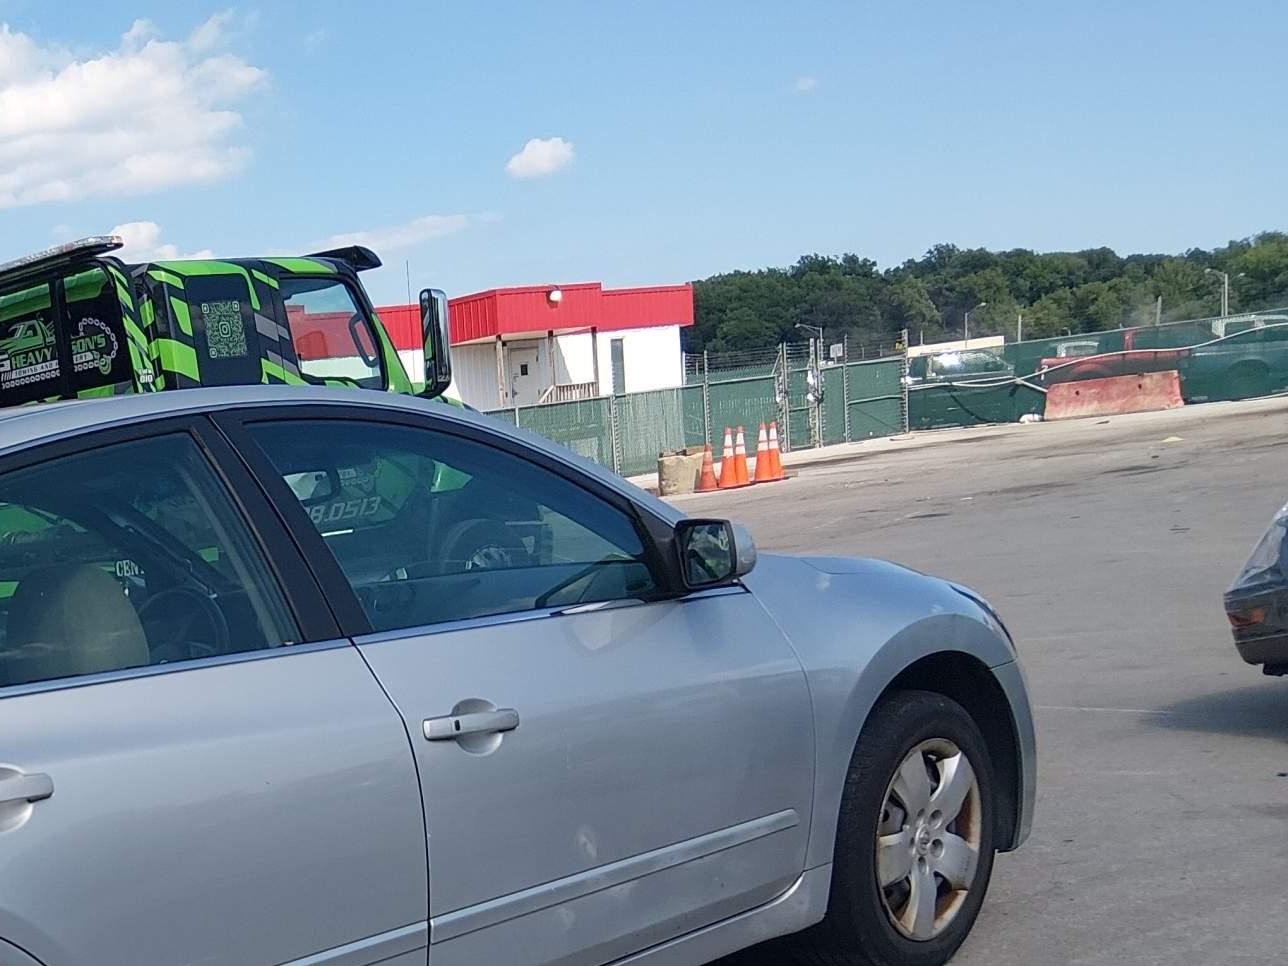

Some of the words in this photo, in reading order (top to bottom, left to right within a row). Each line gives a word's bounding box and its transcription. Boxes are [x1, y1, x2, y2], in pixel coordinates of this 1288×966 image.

[71, 333, 106, 354] SON'S
[12, 347, 53, 369] HEAVY
[305, 496, 381, 524] 8.0513
[115, 559, 145, 577] CEN
